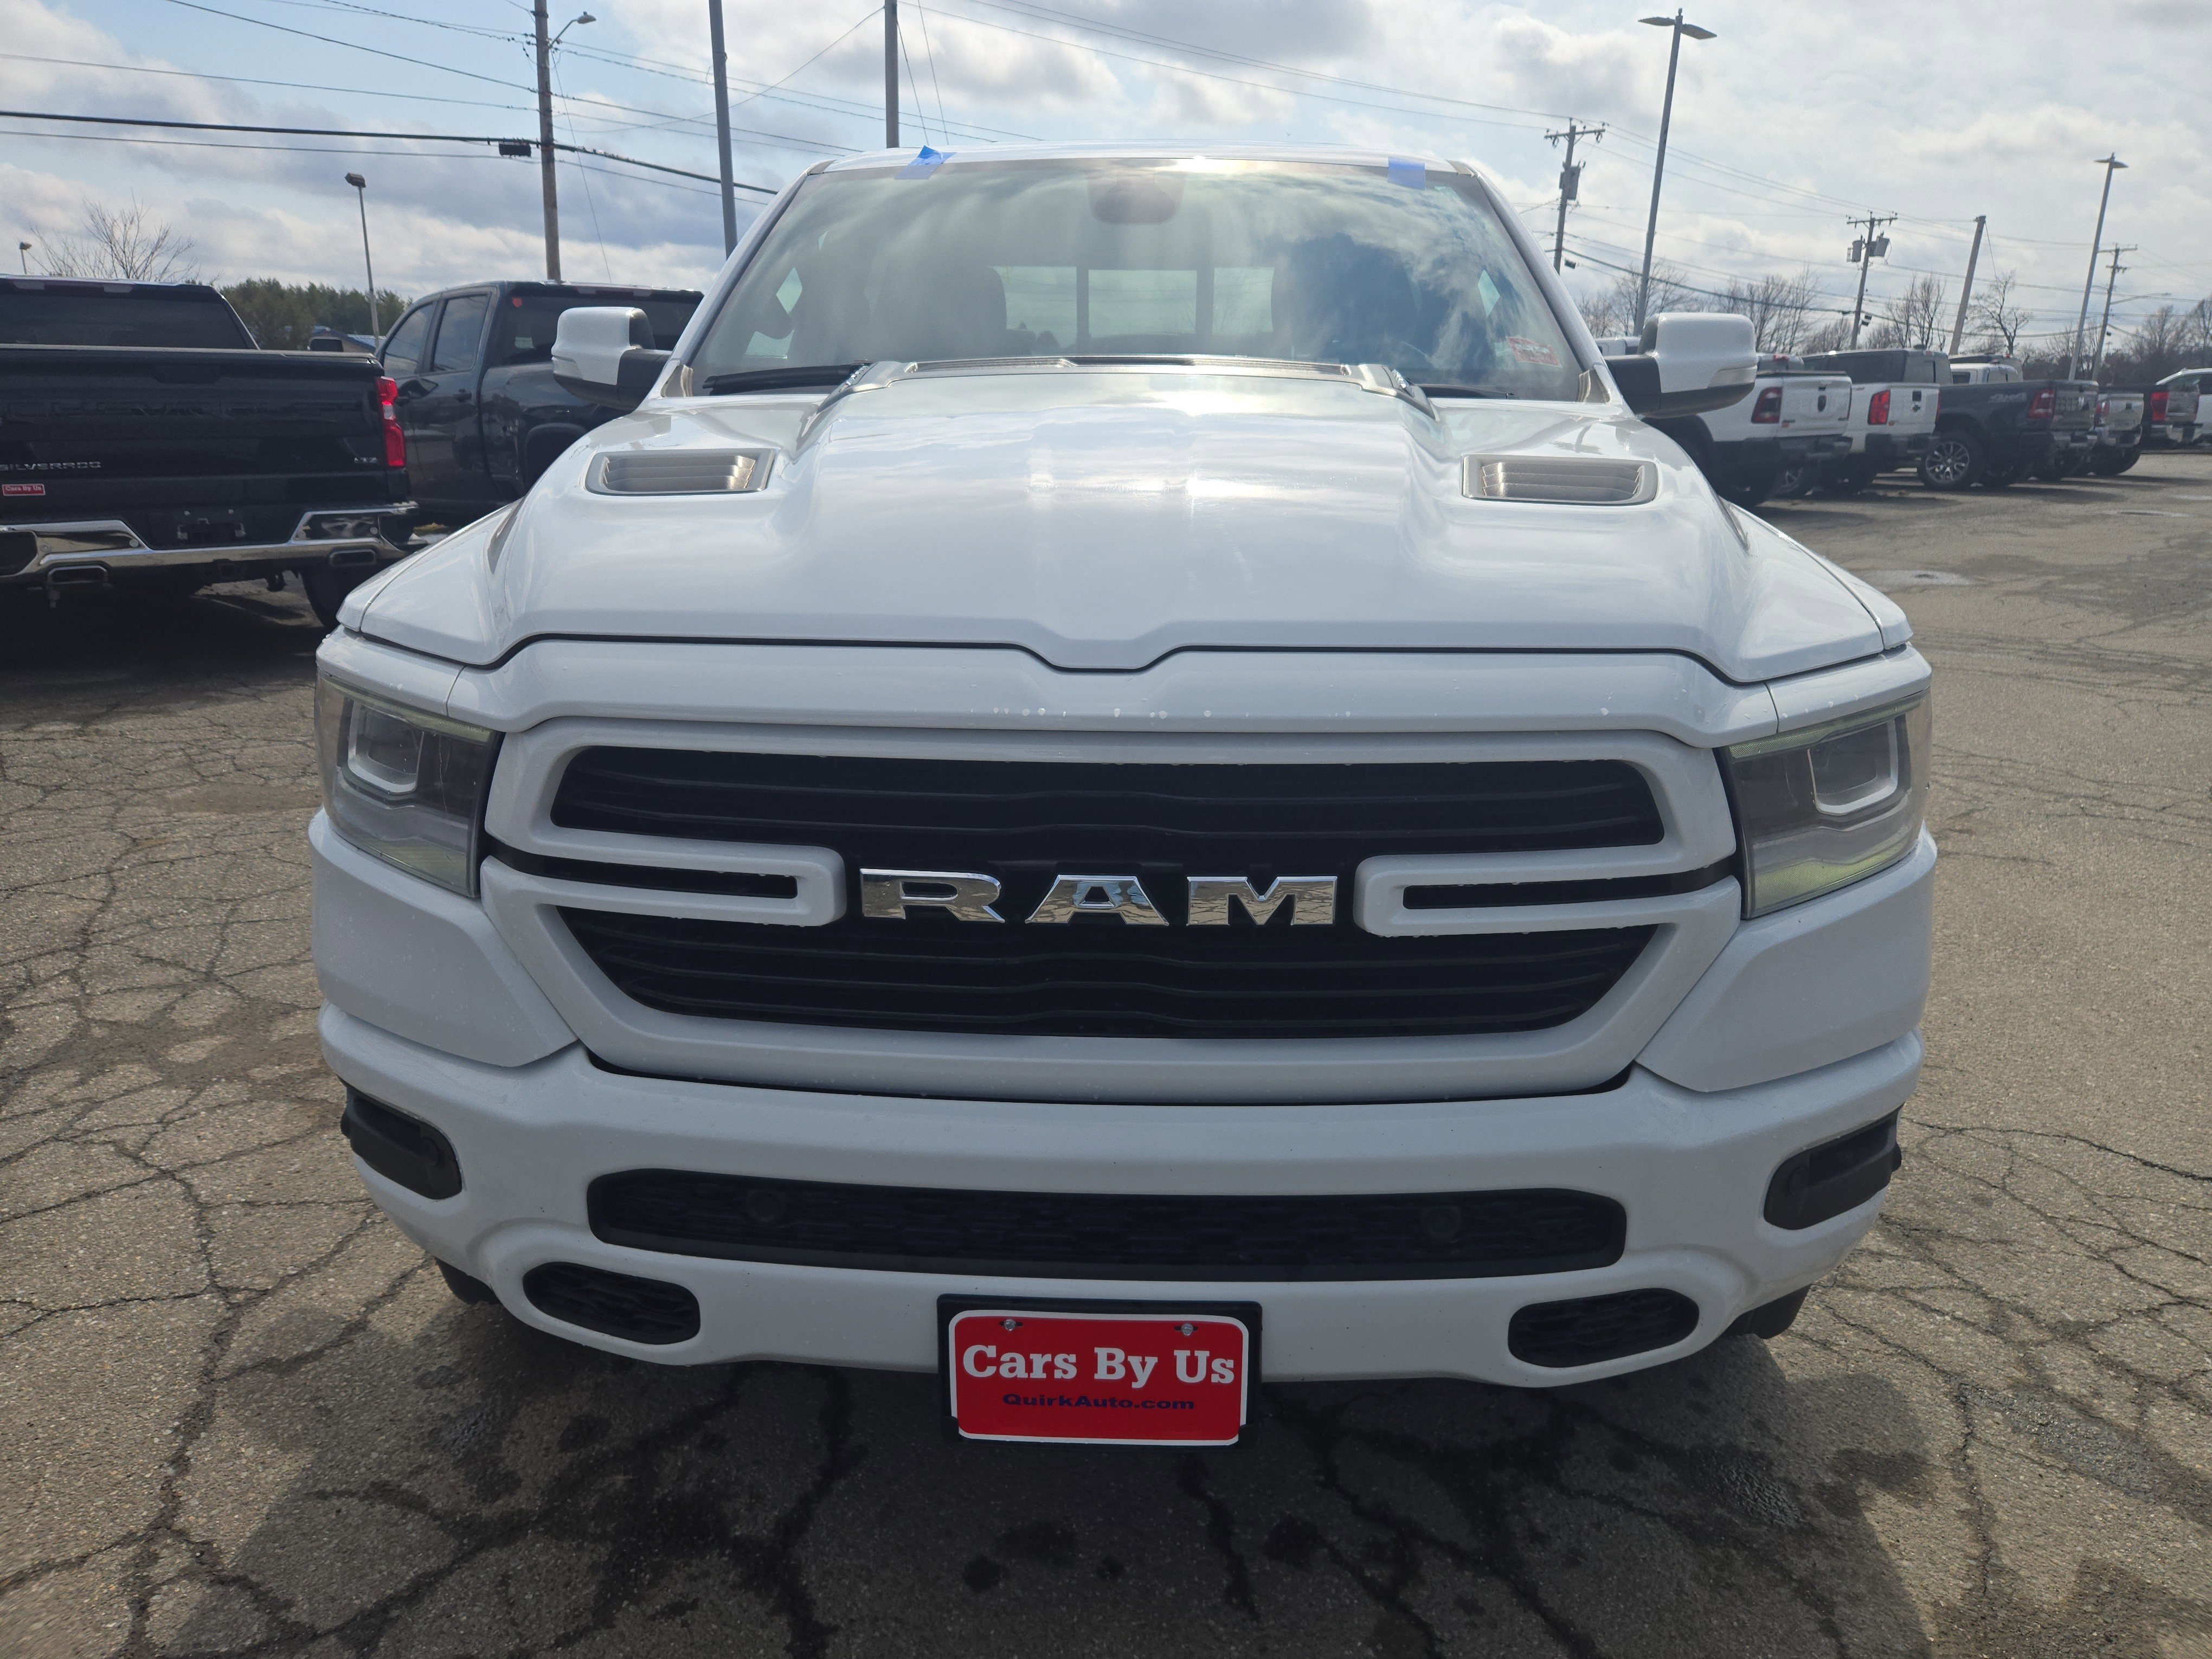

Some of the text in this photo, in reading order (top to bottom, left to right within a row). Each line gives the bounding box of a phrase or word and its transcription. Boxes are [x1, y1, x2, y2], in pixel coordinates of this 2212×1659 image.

[0, 461, 101, 471] SILVERADO
[860, 869, 1338, 926] RAM
[963, 1345, 1234, 1388] Cars By Us
[1003, 1393, 1194, 1410] QuirkAuto.com
